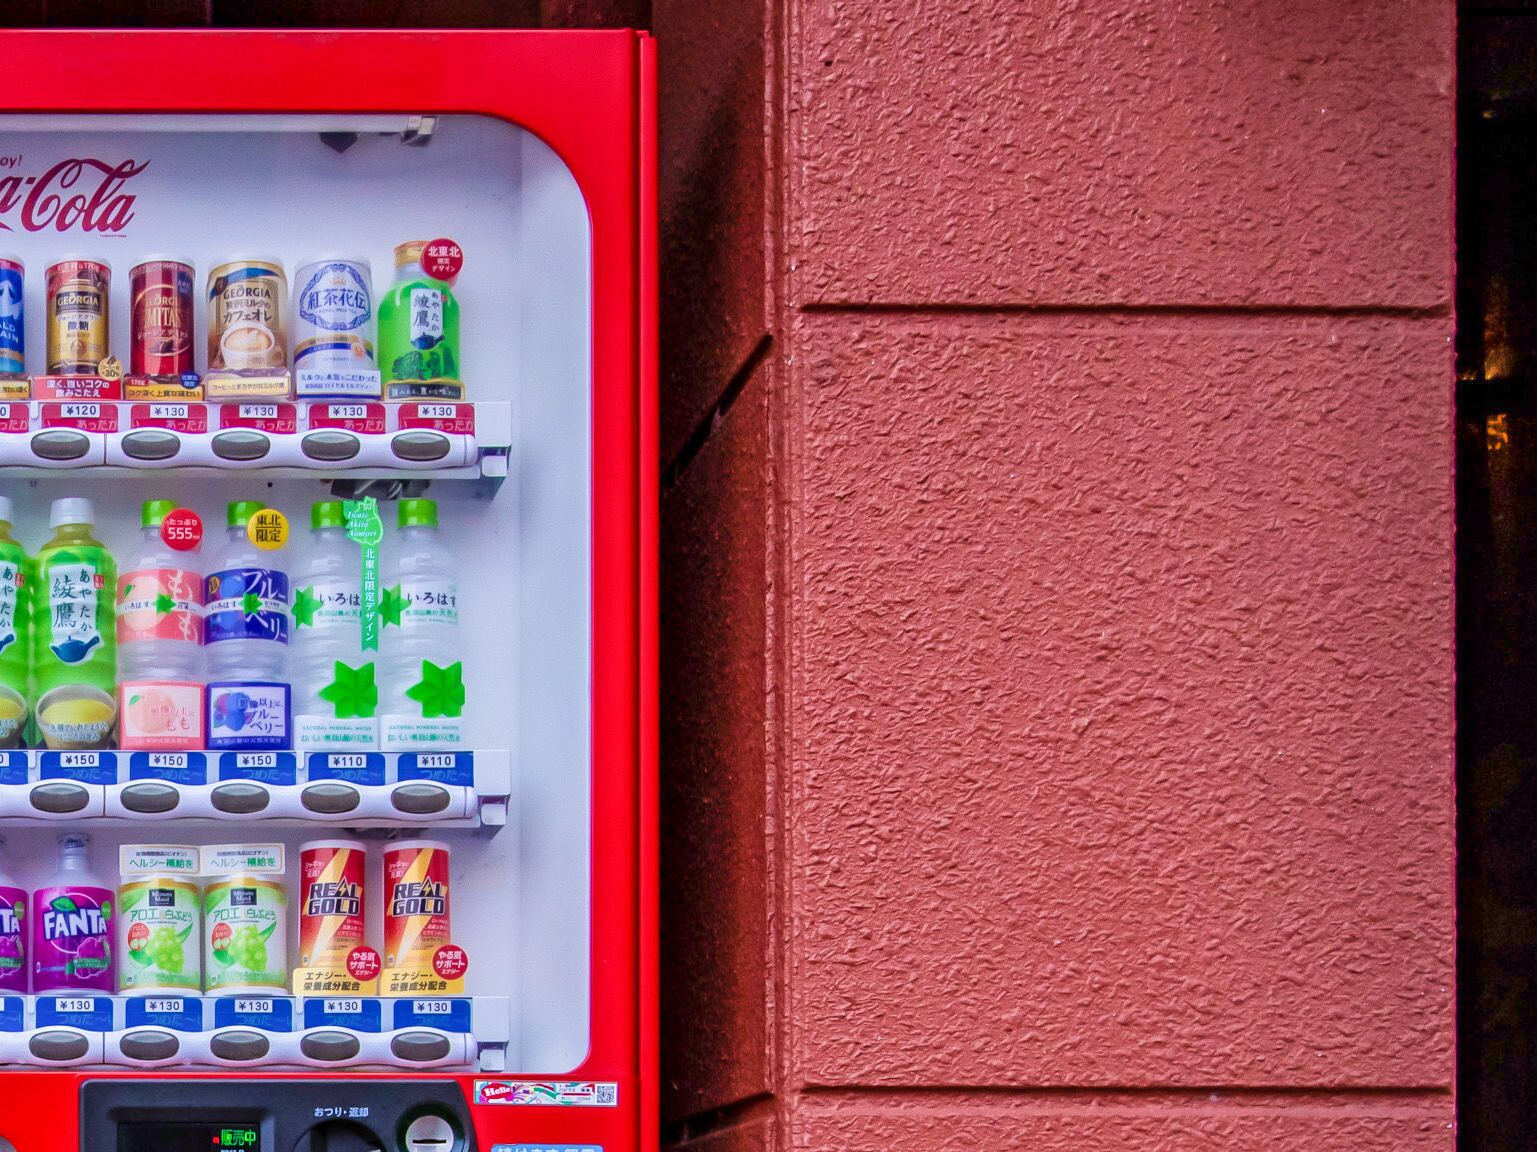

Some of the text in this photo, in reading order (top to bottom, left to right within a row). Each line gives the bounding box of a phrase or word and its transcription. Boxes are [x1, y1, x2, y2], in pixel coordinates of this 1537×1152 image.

[427, 246, 461, 258] 北東北
[431, 264, 455, 274] デザイン
[223, 286, 271, 298] GEORGIA
[57, 292, 99, 306] GEORGIA
[308, 289, 366, 310] 紅茶花伝
[223, 309, 272, 323] カフェオレ
[414, 295, 431, 329] 綾鷹
[431, 292, 441, 333] あやたか
[67, 405, 97, 416] ¥120
[155, 406, 185, 417] ¥130
[243, 406, 274, 416] ¥130
[333, 406, 363, 416] ¥130
[422, 406, 453, 416] ¥130
[167, 518, 197, 526] たっぷり
[257, 515, 281, 526] 東北
[349, 520, 369, 528] Akita
[255, 529, 281, 542] 限定
[0, 566, 14, 628] あやたか
[79, 568, 93, 632] あやたか
[365, 548, 376, 642] 北東北限定デザイン
[53, 575, 77, 628] 綾鷹
[250, 722, 283, 734] ベリー
[65, 754, 95, 765] ¥150
[154, 755, 183, 766] ¥150
[243, 754, 272, 766] ¥150
[333, 756, 363, 766] ¥110
[421, 756, 452, 766] ¥110
[129, 856, 193, 869] ヘルシー補給を
[211, 856, 275, 868] ヘルシー補給を
[309, 876, 360, 899] REAL
[393, 875, 445, 898] REAL
[308, 898, 360, 916] GOLD
[393, 898, 445, 916] GOLD
[43, 908, 107, 939] FANTA
[352, 952, 375, 962] やる気
[438, 951, 462, 960] やる気
[349, 961, 379, 970] サポート
[435, 960, 465, 970] サポート
[303, 982, 361, 992] 栄養成分配合
[390, 982, 448, 992] 栄養成分配合
[59, 1000, 91, 1010] ¥130
[149, 1002, 180, 1011] ¥130
[239, 1002, 269, 1011] ¥130
[327, 1002, 359, 1011] ¥130
[417, 1002, 448, 1012] ¥130
[483, 1086, 511, 1097] Hello
[314, 1107, 369, 1118] おつり・返却
[221, 1129, 257, 1147] 販売中
